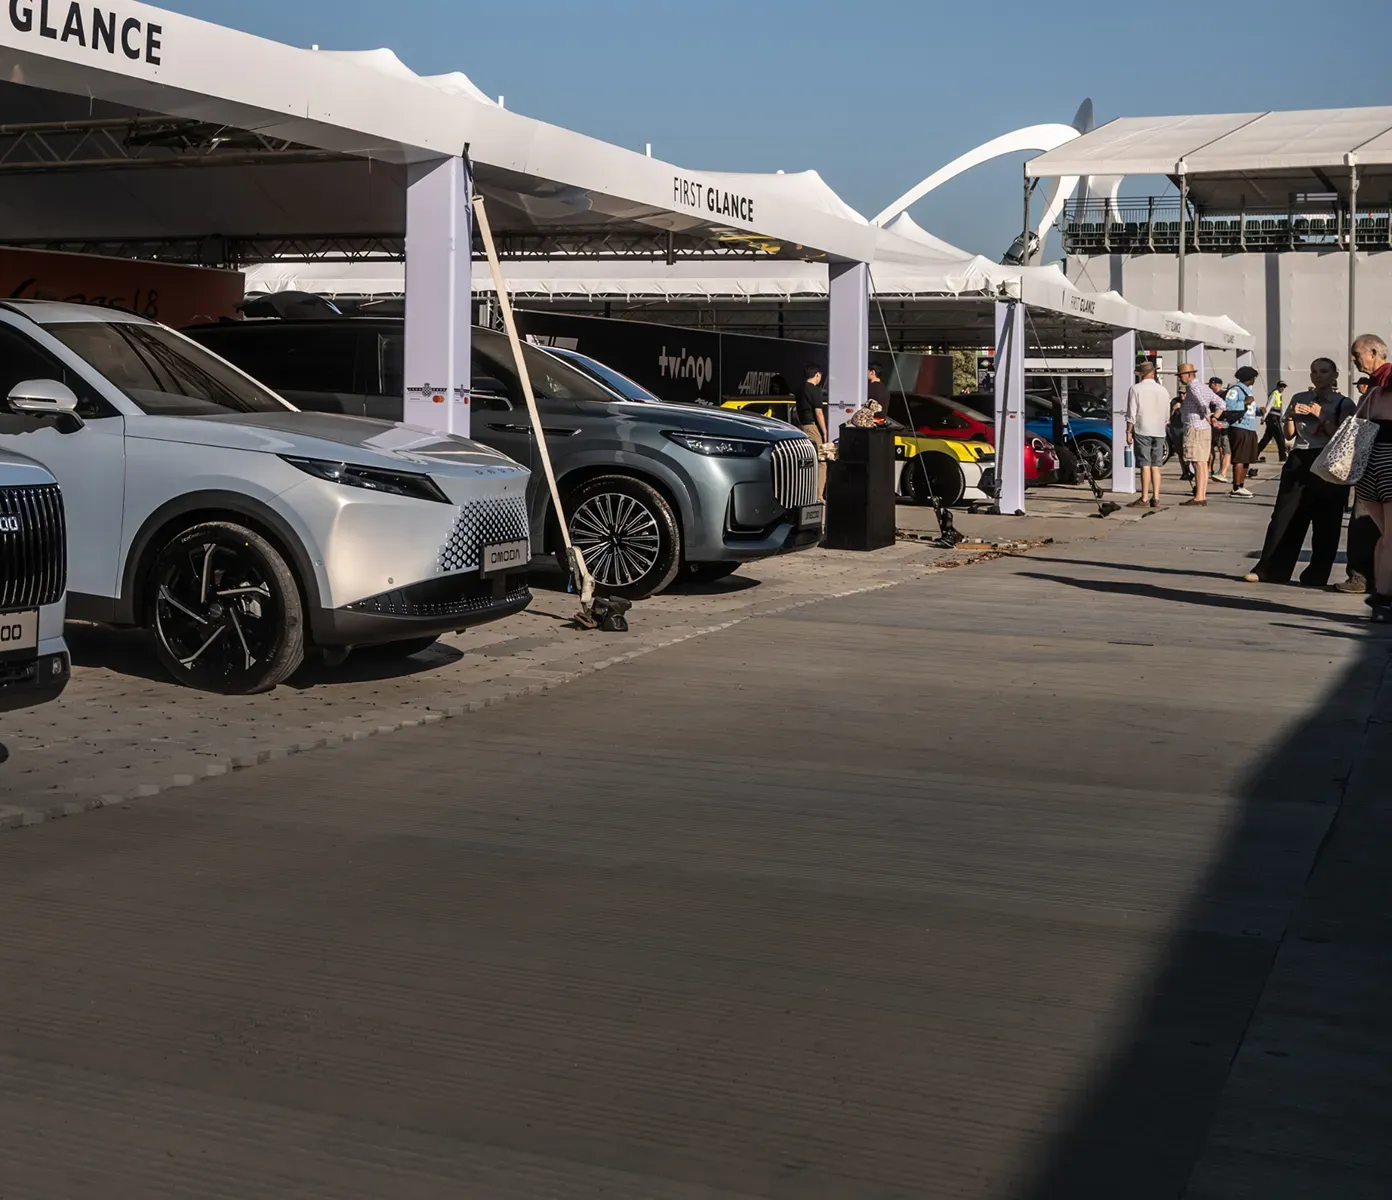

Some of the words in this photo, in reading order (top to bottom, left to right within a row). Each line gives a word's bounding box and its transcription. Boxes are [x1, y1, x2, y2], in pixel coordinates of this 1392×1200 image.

[8, 0, 163, 66] GLANCE
[673, 176, 703, 208] FIRST
[707, 187, 754, 223] GLANCE
[658, 345, 713, 391] twingo
[490, 549, 520, 564] OMODA
